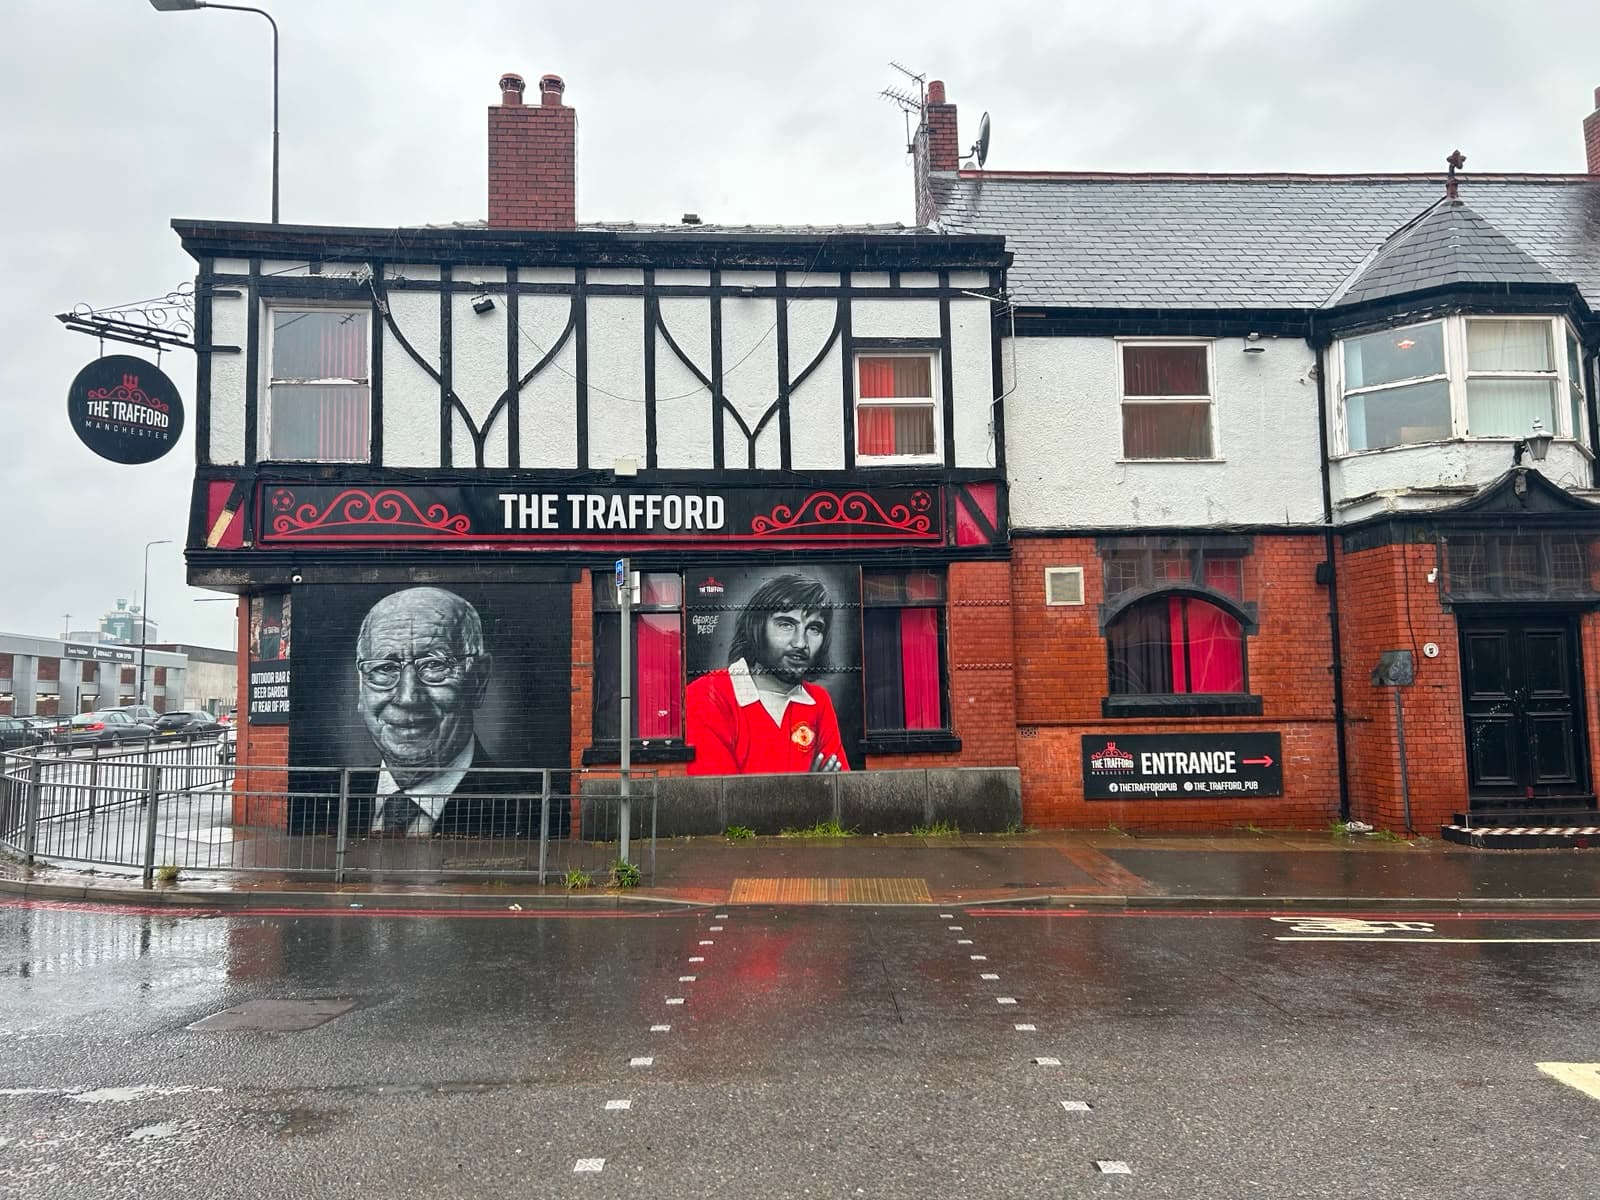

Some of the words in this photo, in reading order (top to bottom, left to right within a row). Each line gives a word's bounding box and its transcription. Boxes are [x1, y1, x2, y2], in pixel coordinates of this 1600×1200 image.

[87, 401, 110, 418] THE
[112, 401, 169, 428] TRAFFORD
[85, 420, 168, 440] MANCHESTER
[498, 494, 559, 529] THE
[566, 494, 725, 530] TRAFFORD
[692, 615, 719, 624] GEORGE
[697, 624, 716, 634] BEST
[251, 672, 275, 684] OUTDOOR
[275, 671, 286, 682] BAR
[254, 687, 267, 698] BEER
[267, 686, 288, 698] GARDEN
[251, 701, 258, 712] AT
[258, 701, 272, 712] REAR
[272, 701, 279, 712] OF
[1091, 759, 1104, 769] THE
[1103, 757, 1134, 769] TRAFFORD
[1140, 751, 1237, 775] ENTRANCE
[1119, 782, 1178, 792] THETRAFFORDPUB
[1194, 781, 1259, 792] THE_TRAFFORD_PUB
